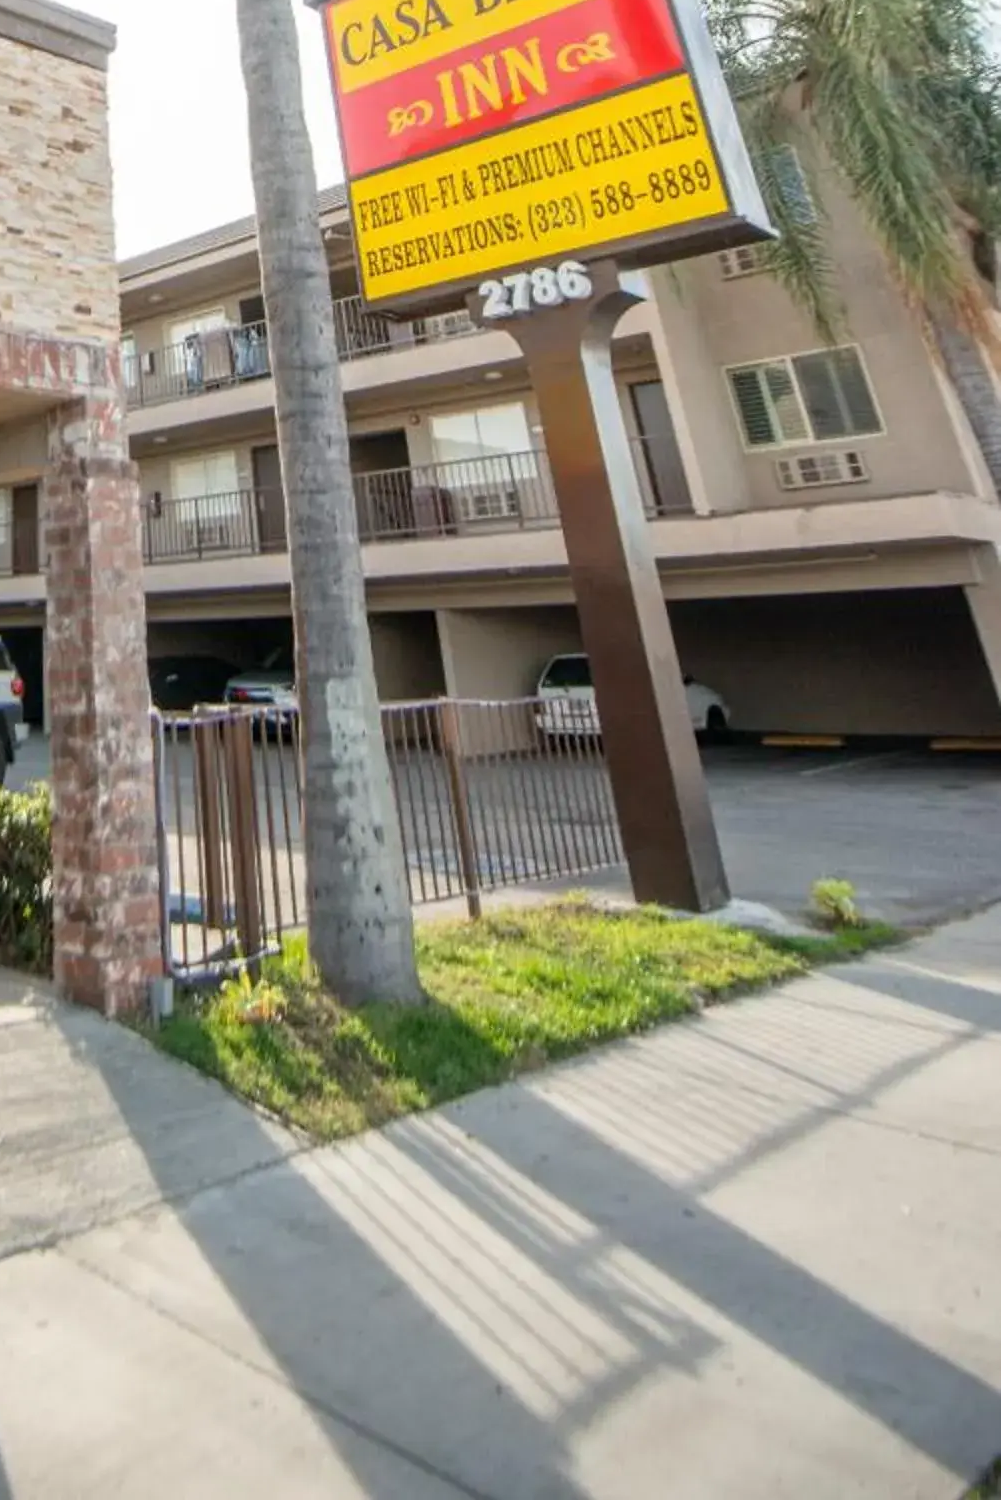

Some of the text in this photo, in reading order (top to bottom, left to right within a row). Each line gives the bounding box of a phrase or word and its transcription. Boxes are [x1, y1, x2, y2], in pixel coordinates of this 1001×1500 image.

[435, 37, 549, 129] INN
[358, 101, 698, 232] FREE WI-FI & PREMIUM CHANNELS
[367, 160, 711, 277] RESERVATIONS: (323) 588-8889
[478, 260, 593, 319] 2786
